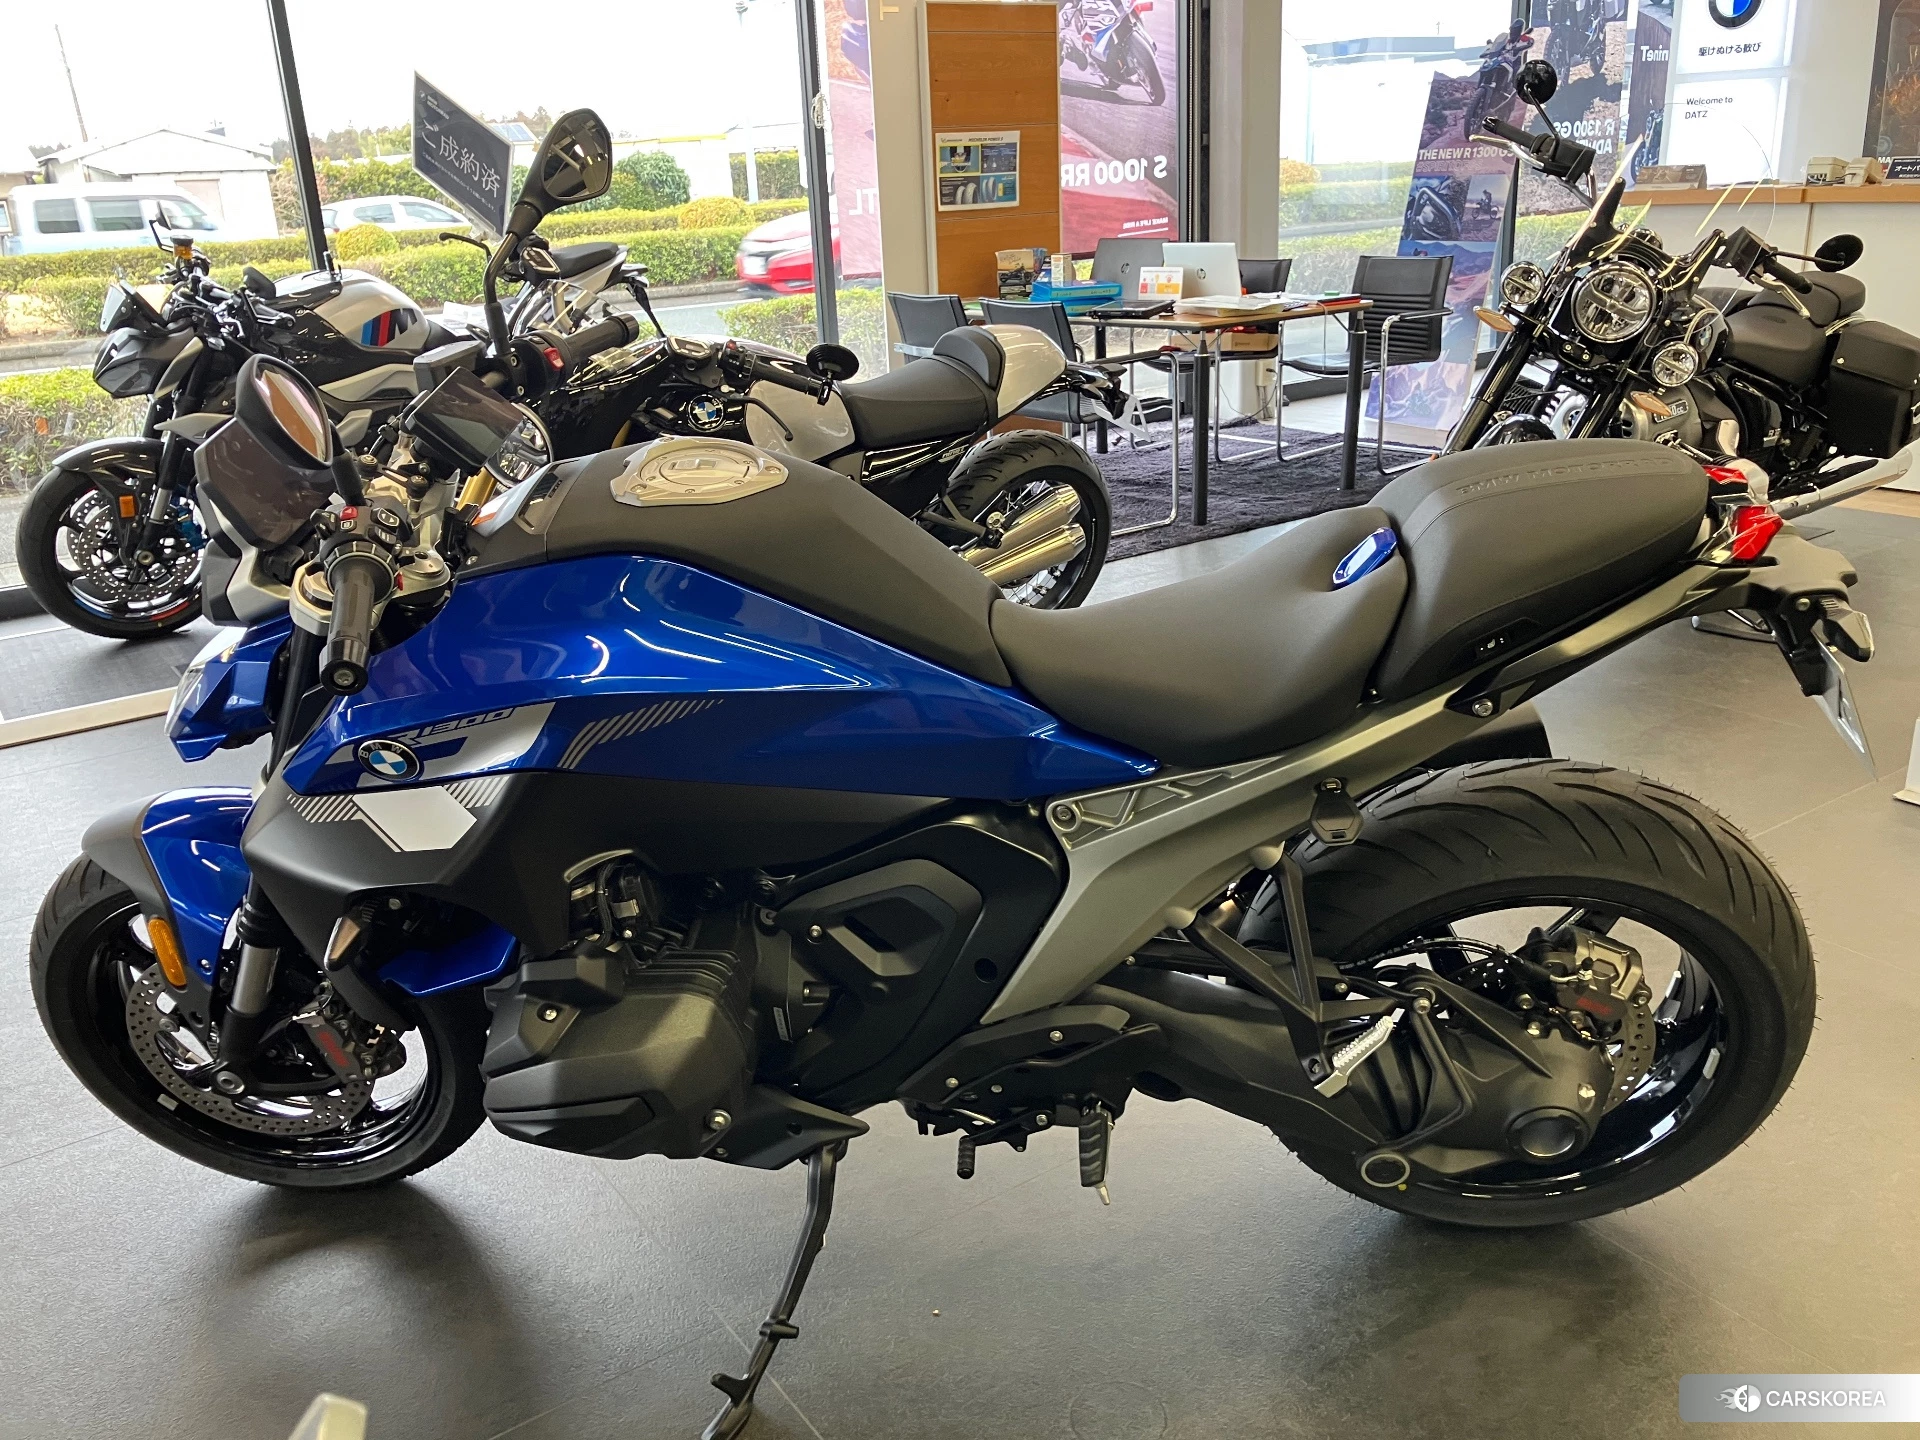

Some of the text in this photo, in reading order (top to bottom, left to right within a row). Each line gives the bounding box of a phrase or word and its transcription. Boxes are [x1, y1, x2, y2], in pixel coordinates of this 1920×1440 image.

[1698, 42, 1762, 57] 駆けぬける歓び
[1686, 96, 1734, 106] Welcome to
[1685, 110, 1709, 120] DATZ
[422, 118, 501, 198] ご成約済
[1418, 149, 1438, 160] THE
[1438, 147, 1463, 160] NEW
[1463, 147, 1472, 159] R
[1472, 146, 1498, 158] 1300
[1456, 456, 1676, 495] BMW MOTORRAD
[359, 741, 403, 759] BMW
